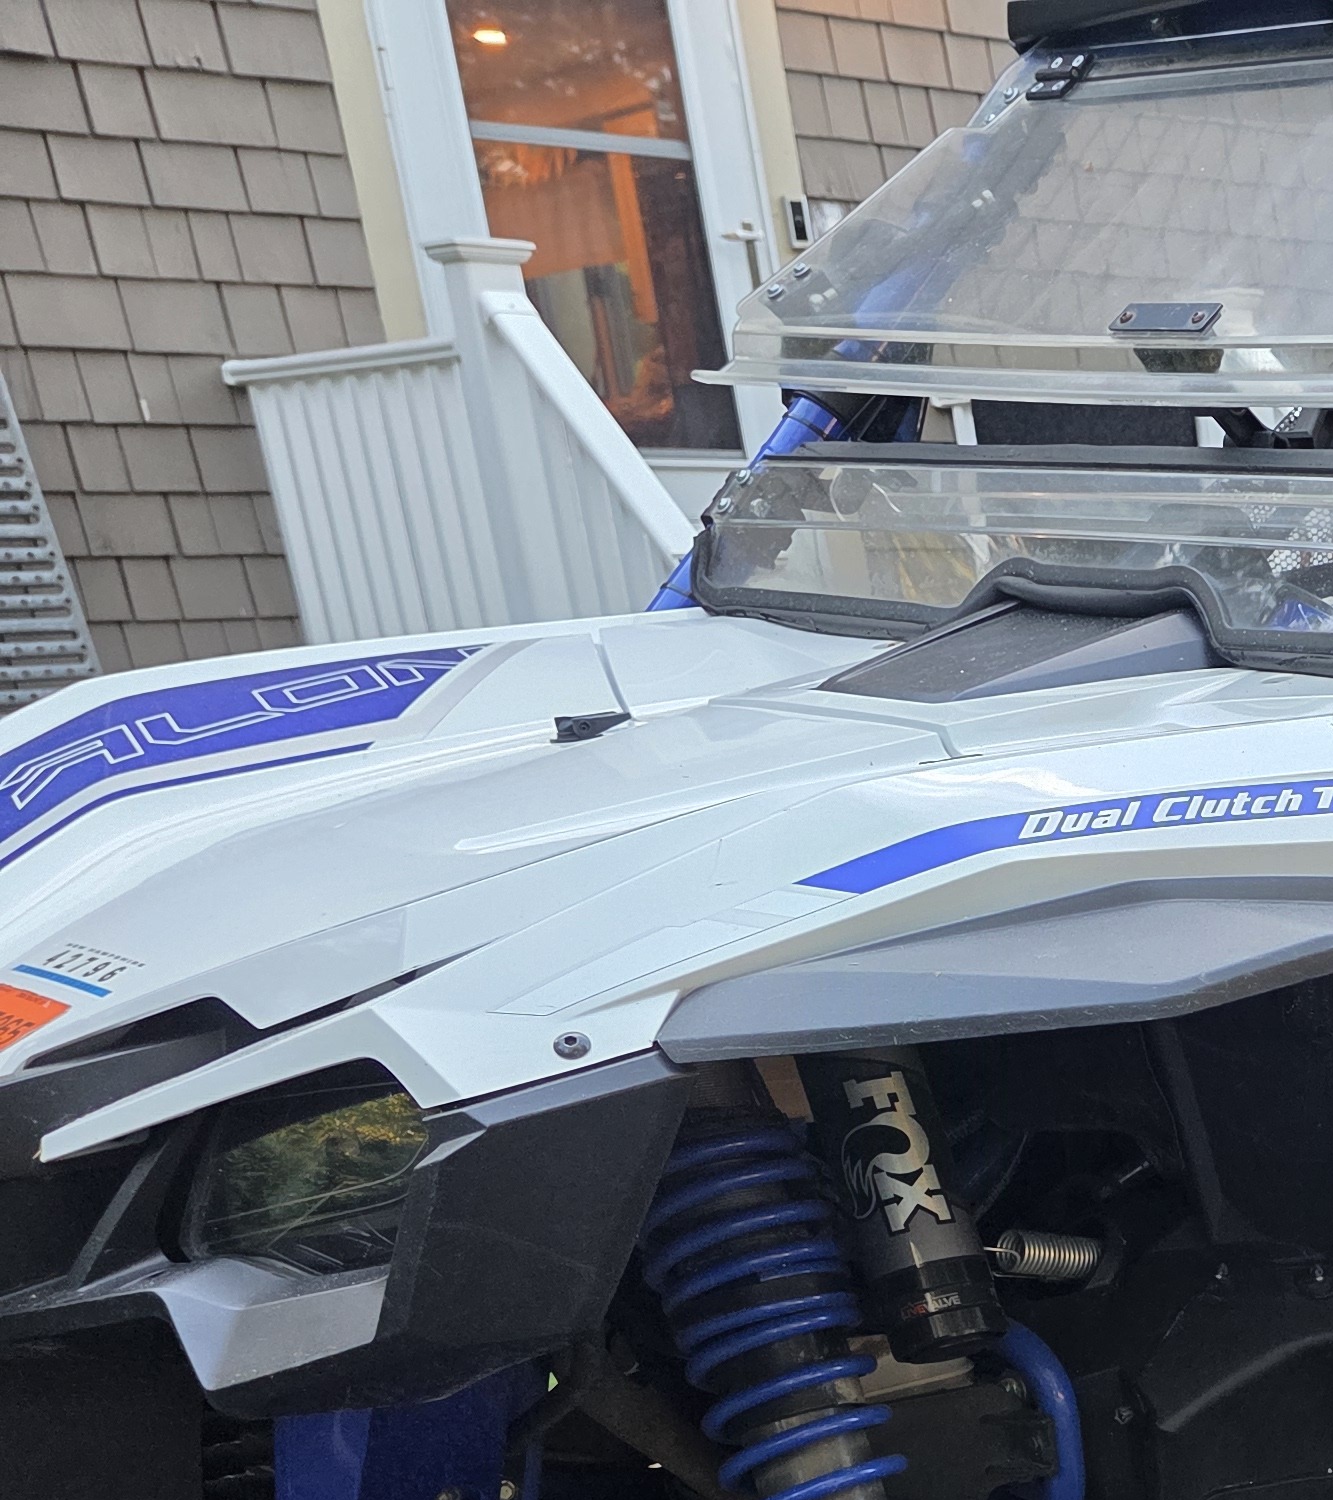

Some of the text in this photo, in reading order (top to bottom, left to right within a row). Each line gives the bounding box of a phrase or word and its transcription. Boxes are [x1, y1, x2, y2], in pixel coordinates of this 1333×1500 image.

[1018, 800, 1137, 840] Dual
[1152, 785, 1302, 825] Clutch
[43, 950, 127, 982] 42796
[841, 1070, 955, 1232] FOX
